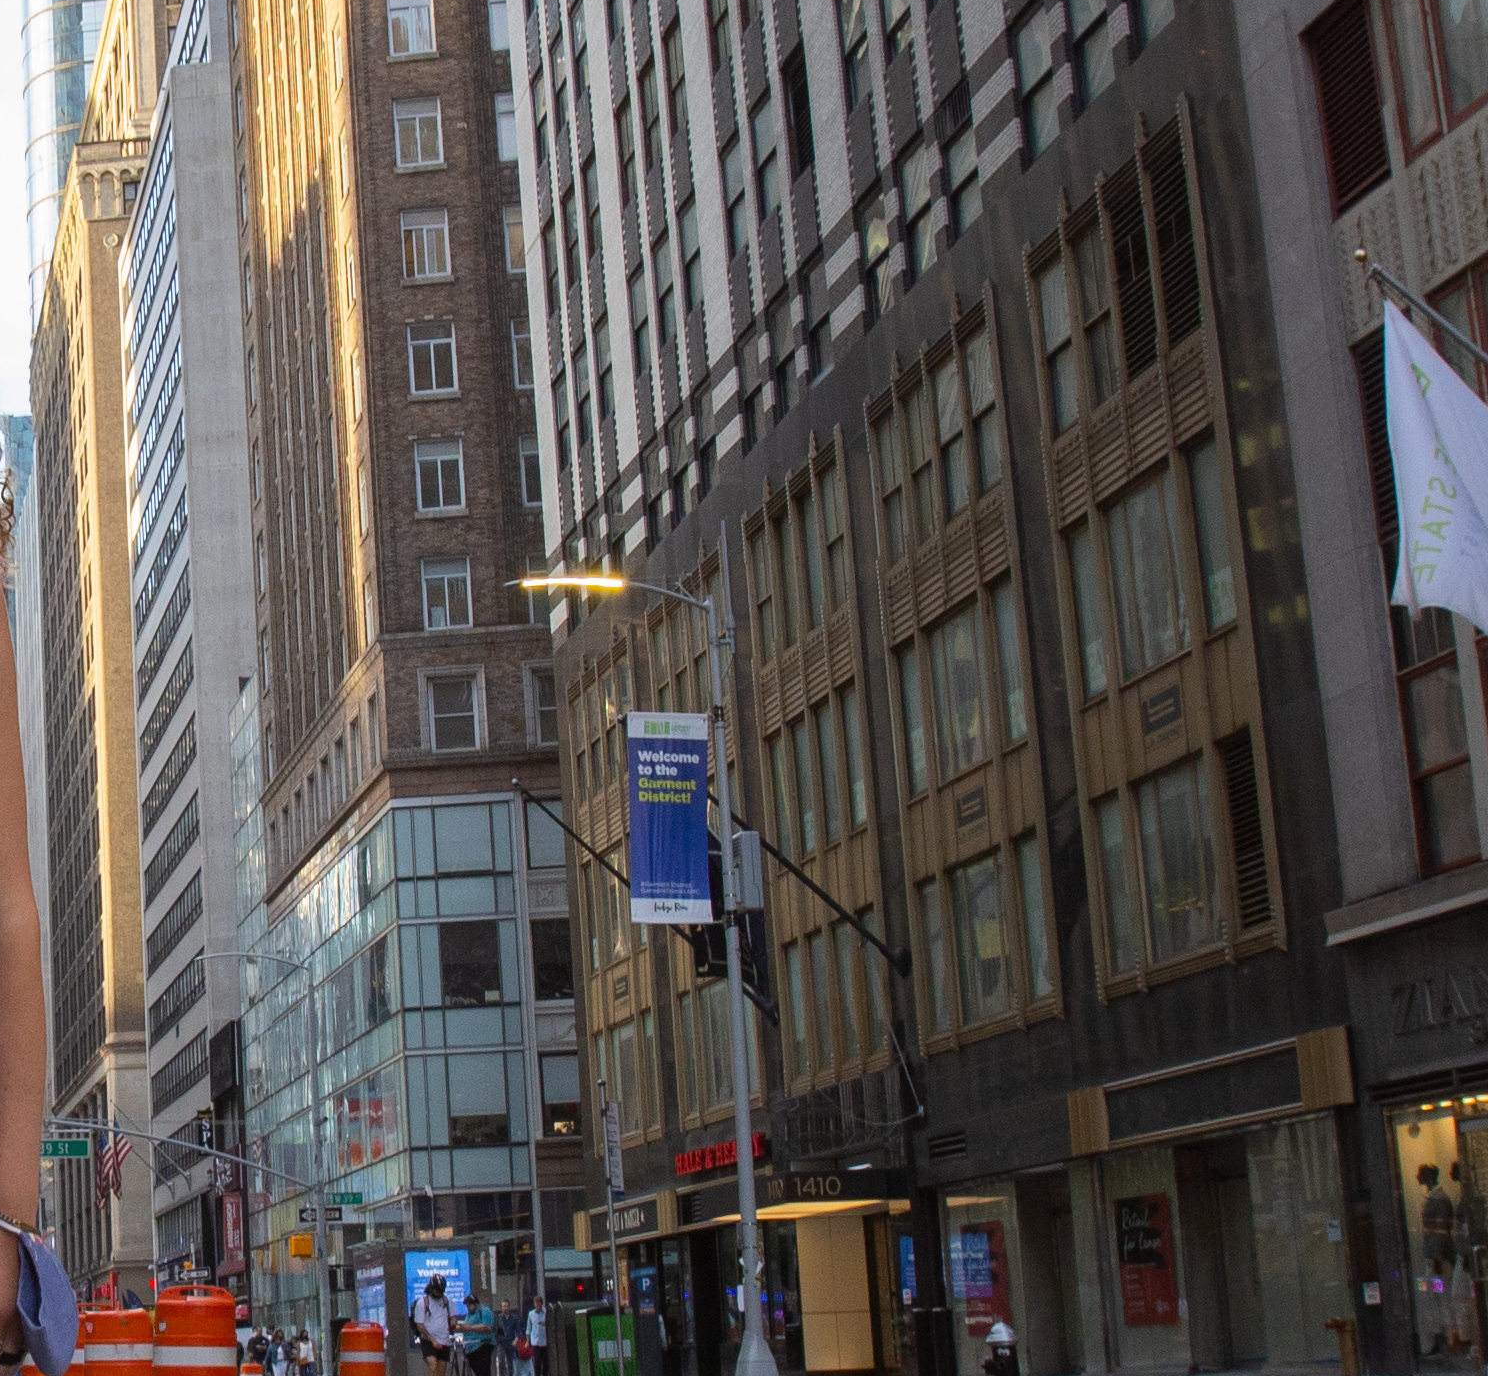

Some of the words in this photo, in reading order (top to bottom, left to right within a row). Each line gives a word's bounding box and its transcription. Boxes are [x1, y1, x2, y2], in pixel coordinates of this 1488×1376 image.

[637, 750, 701, 764] Welcome
[637, 764, 653, 776] to
[654, 764, 679, 776] the
[638, 777, 698, 790] Garment
[638, 790, 693, 804] District!
[58, 1142, 69, 1154] St
[675, 1148, 703, 1176] HALE
[793, 1176, 842, 1198] 1410
[425, 1258, 449, 1268] New
[416, 1267, 460, 1278] Yorkers!
[640, 1277, 652, 1292] P
